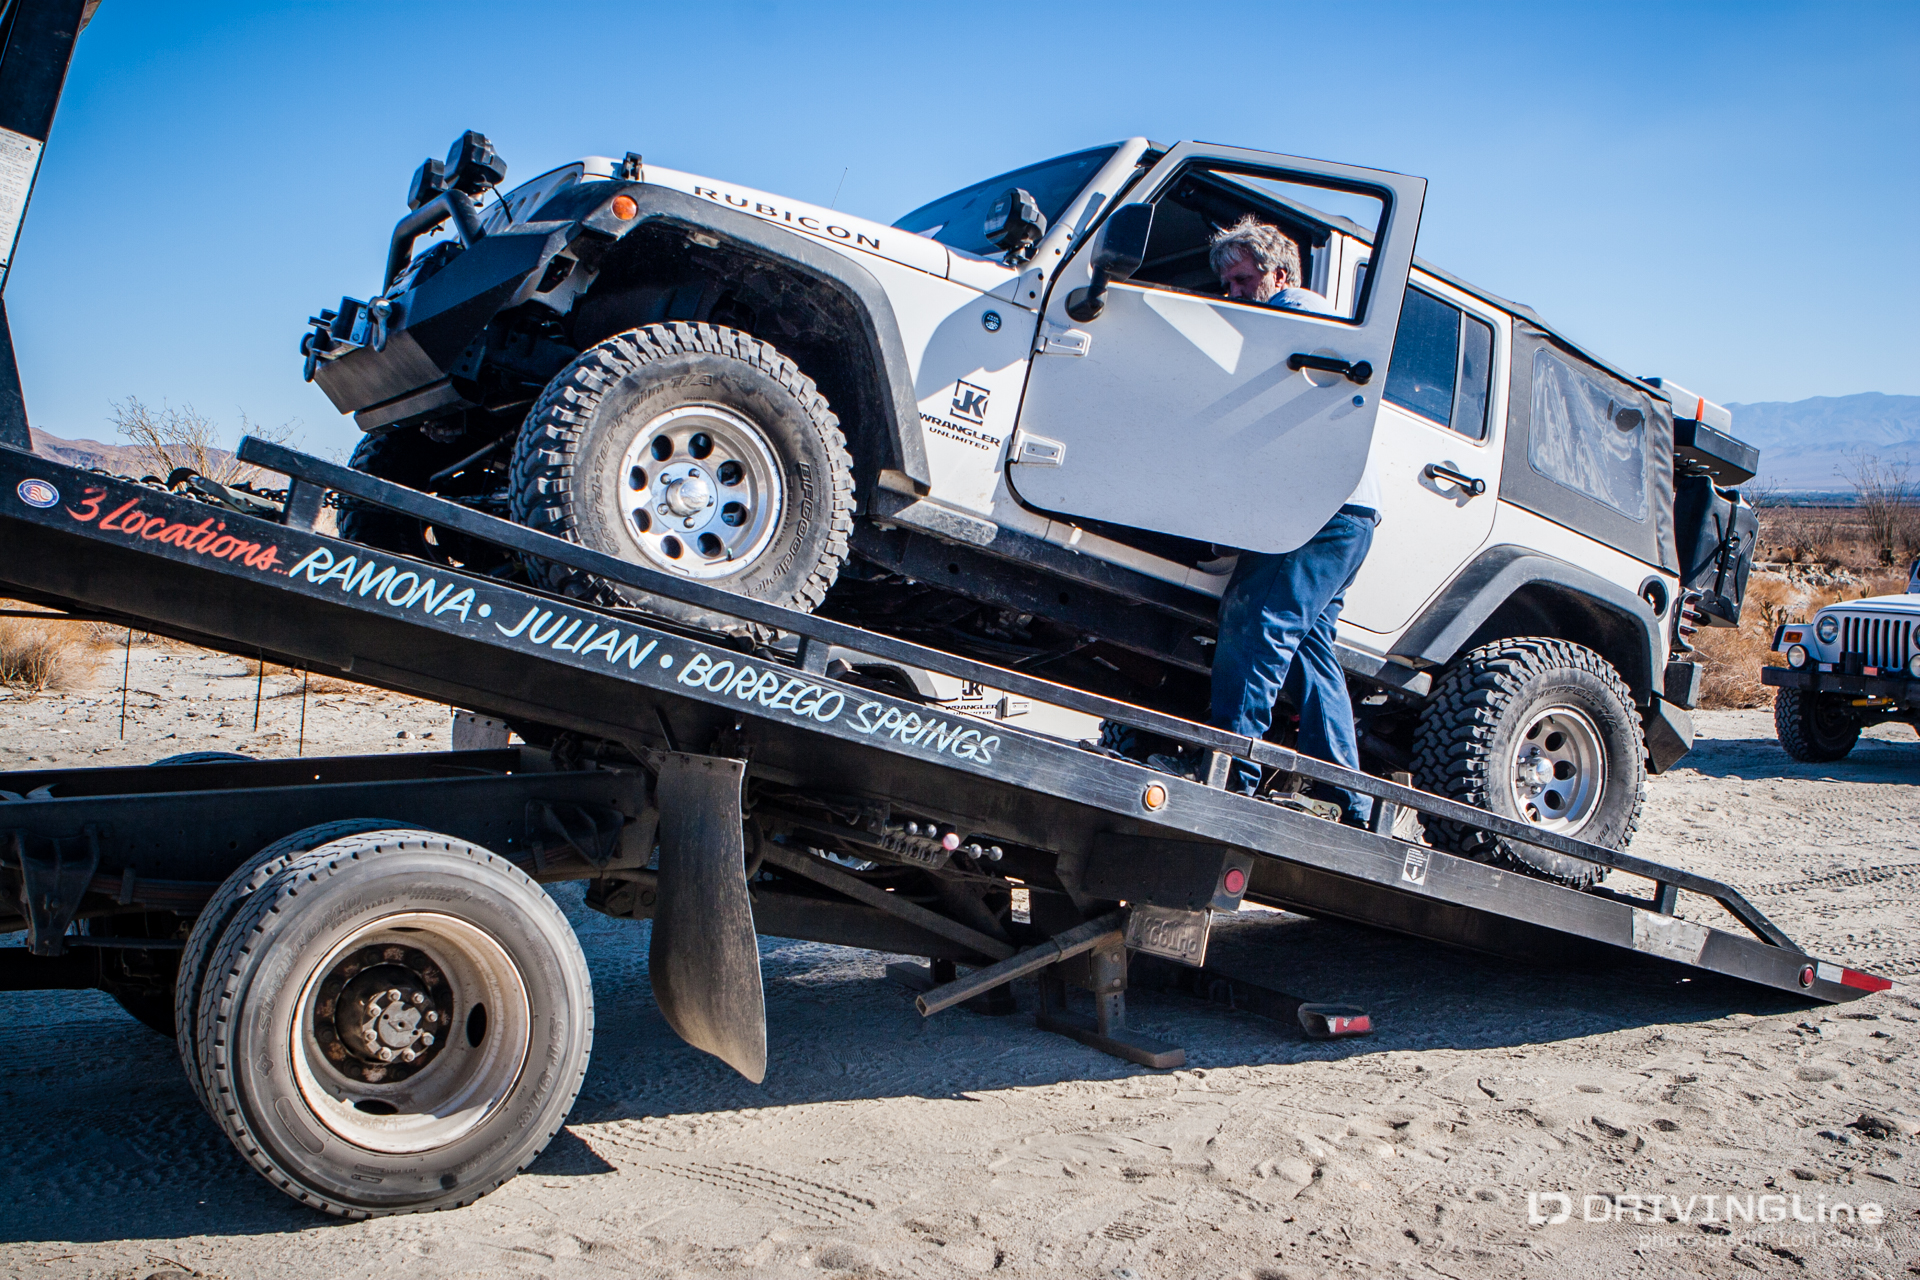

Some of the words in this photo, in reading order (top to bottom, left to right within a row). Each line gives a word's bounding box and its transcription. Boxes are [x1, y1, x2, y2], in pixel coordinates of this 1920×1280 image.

[694, 185, 881, 251] RUBICON
[952, 389, 987, 420] JK
[919, 411, 1001, 447] WRANGLER
[928, 426, 989, 451] UNLIMITED
[65, 487, 102, 523] 3
[288, 546, 476, 624] RAMONA
[494, 606, 657, 670] JULIAN
[677, 652, 844, 723] BORREGO
[846, 701, 1000, 766] SPRINGS
